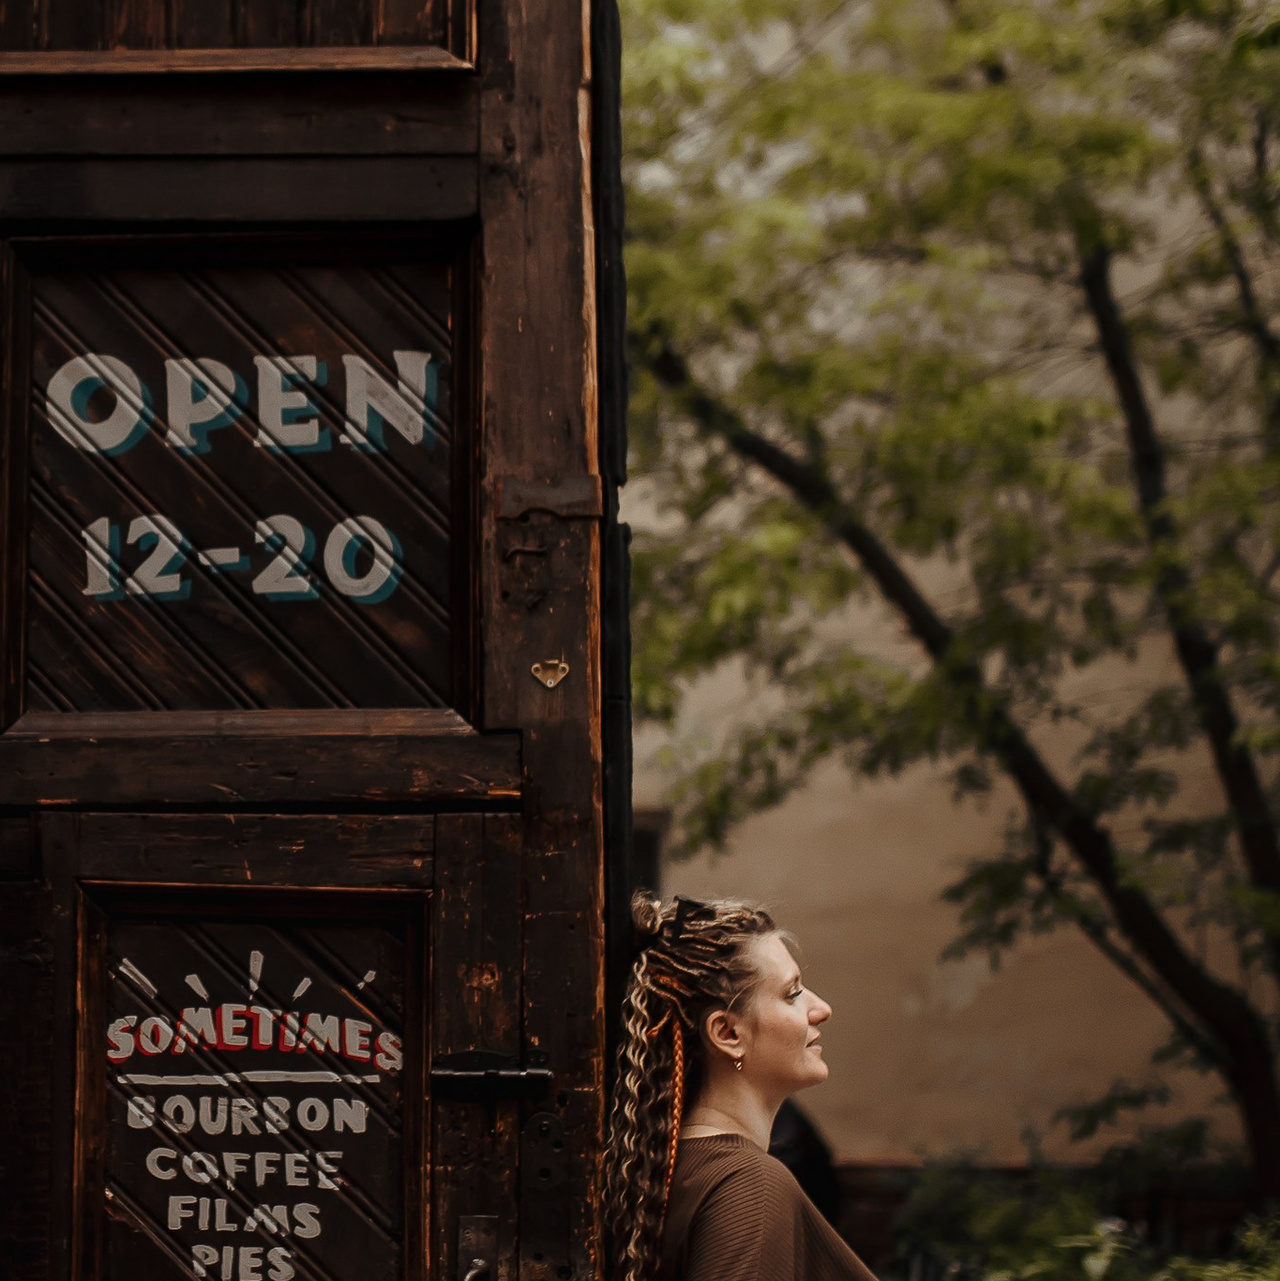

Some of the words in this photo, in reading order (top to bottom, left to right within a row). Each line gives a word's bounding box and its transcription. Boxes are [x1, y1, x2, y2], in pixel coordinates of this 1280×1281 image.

[45, 350, 442, 457] OPEN
[82, 514, 404, 604] 12-20
[107, 1003, 404, 1072] SOMETIMES
[126, 1094, 370, 1136] BOURBON
[145, 1146, 344, 1192] COFFEE
[167, 1195, 322, 1239] FILMS
